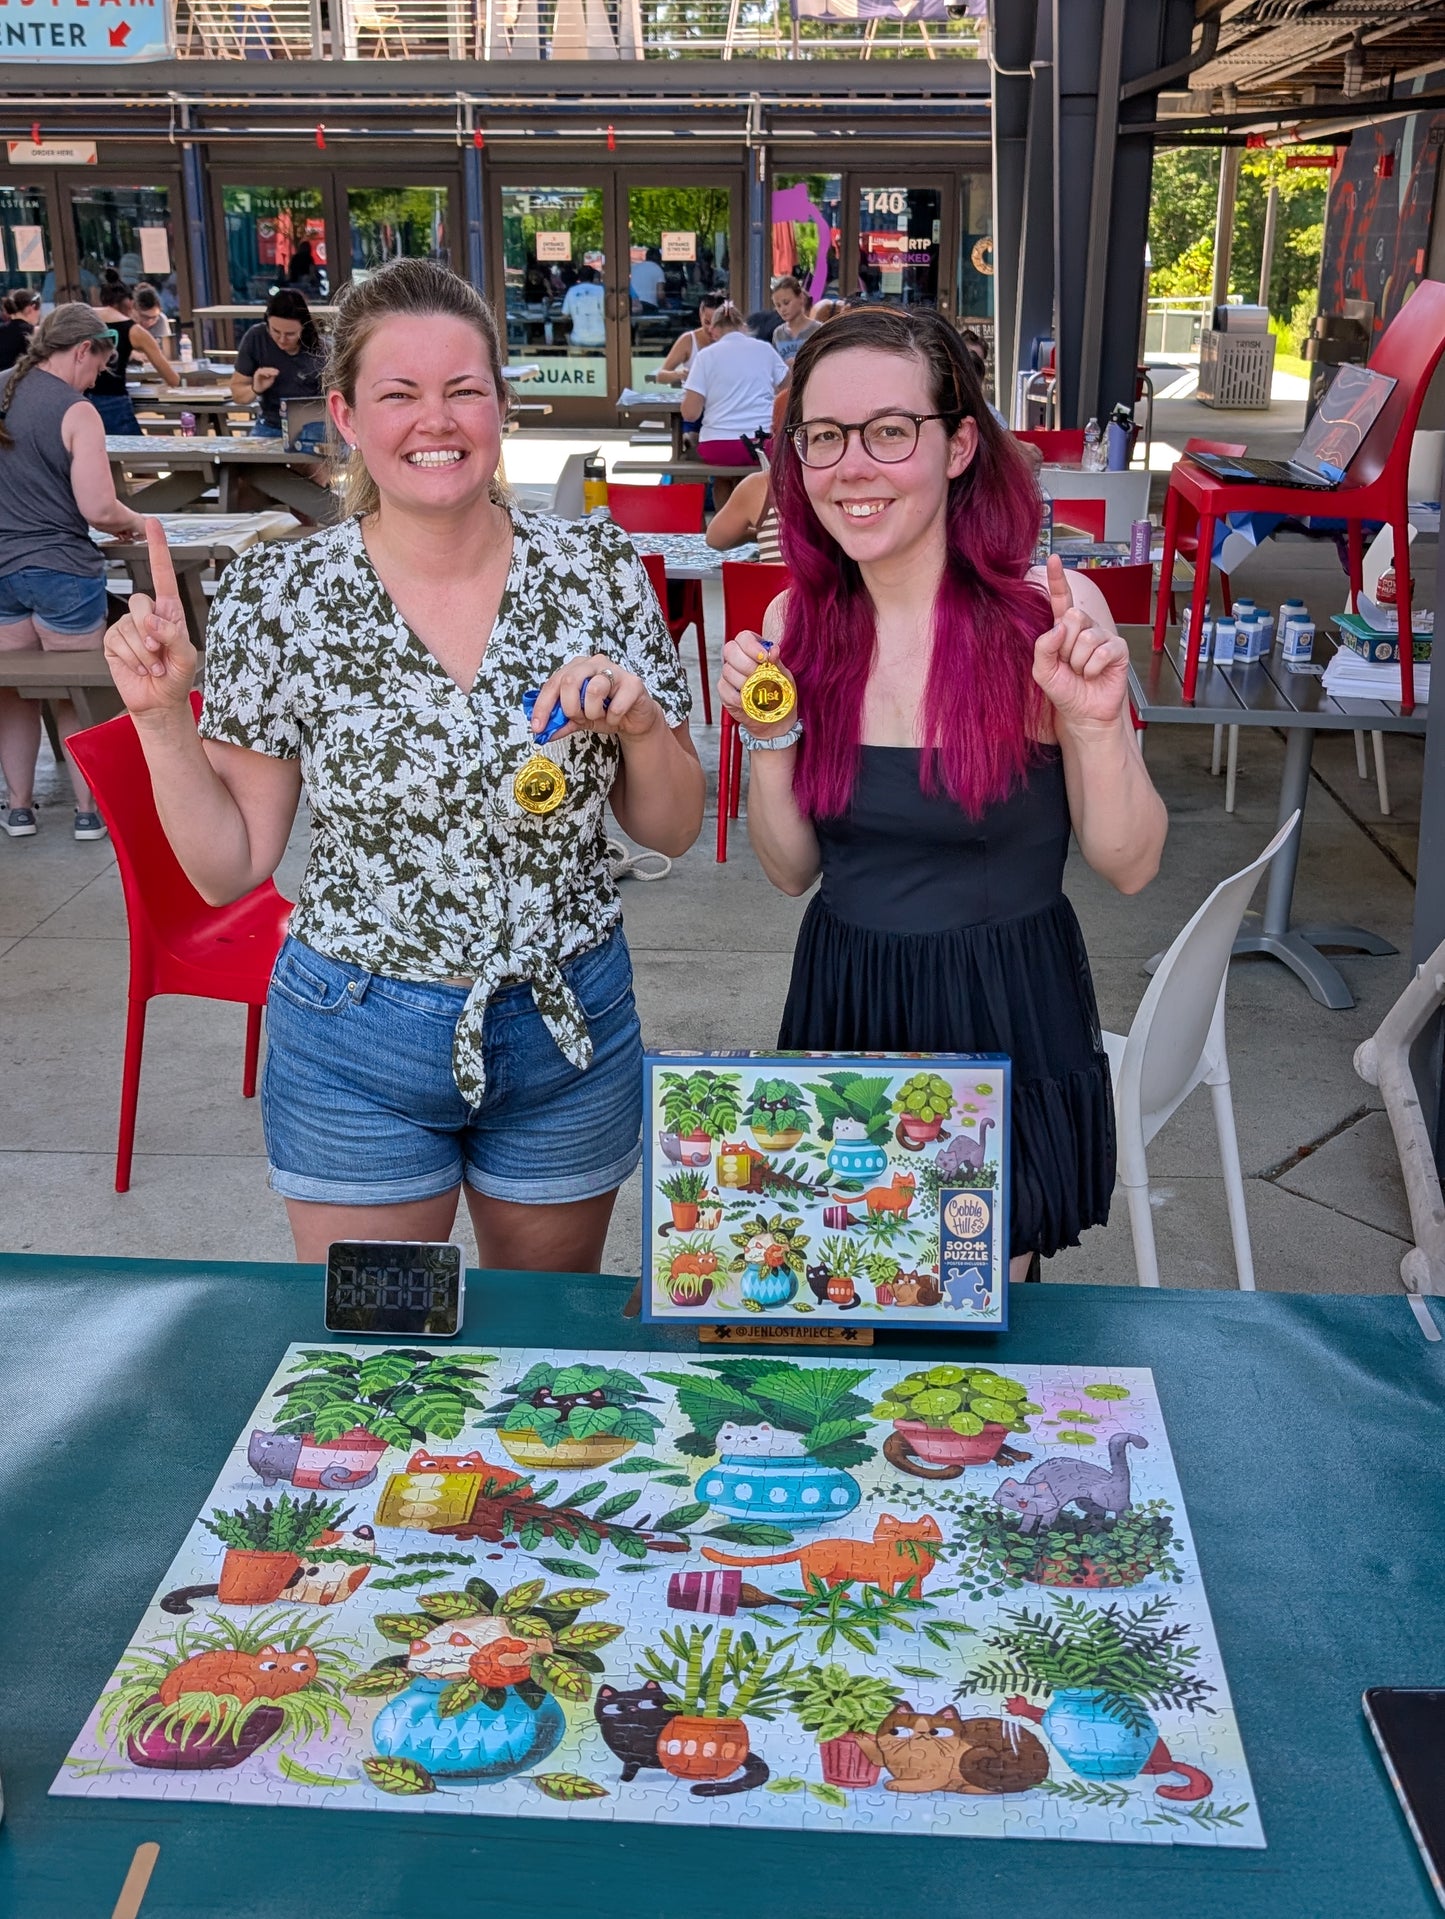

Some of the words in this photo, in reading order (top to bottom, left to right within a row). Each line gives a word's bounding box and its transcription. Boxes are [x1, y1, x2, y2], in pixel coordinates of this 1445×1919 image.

[0, 22, 87, 47] NTER
[31, 149, 55, 157] ORDER
[56, 149, 75, 157] HERE
[864, 192, 904, 214] 140
[908, 238, 932, 250] RTP
[523, 369, 595, 383] QUARE
[529, 778, 551, 797] 1st
[948, 1199, 983, 1218] Cobble
[953, 1217, 971, 1235] Hill
[946, 1241, 973, 1250] 500
[944, 1251, 989, 1261] PUZZLE
[735, 1326, 834, 1338] @JENLOSTAPIECE
